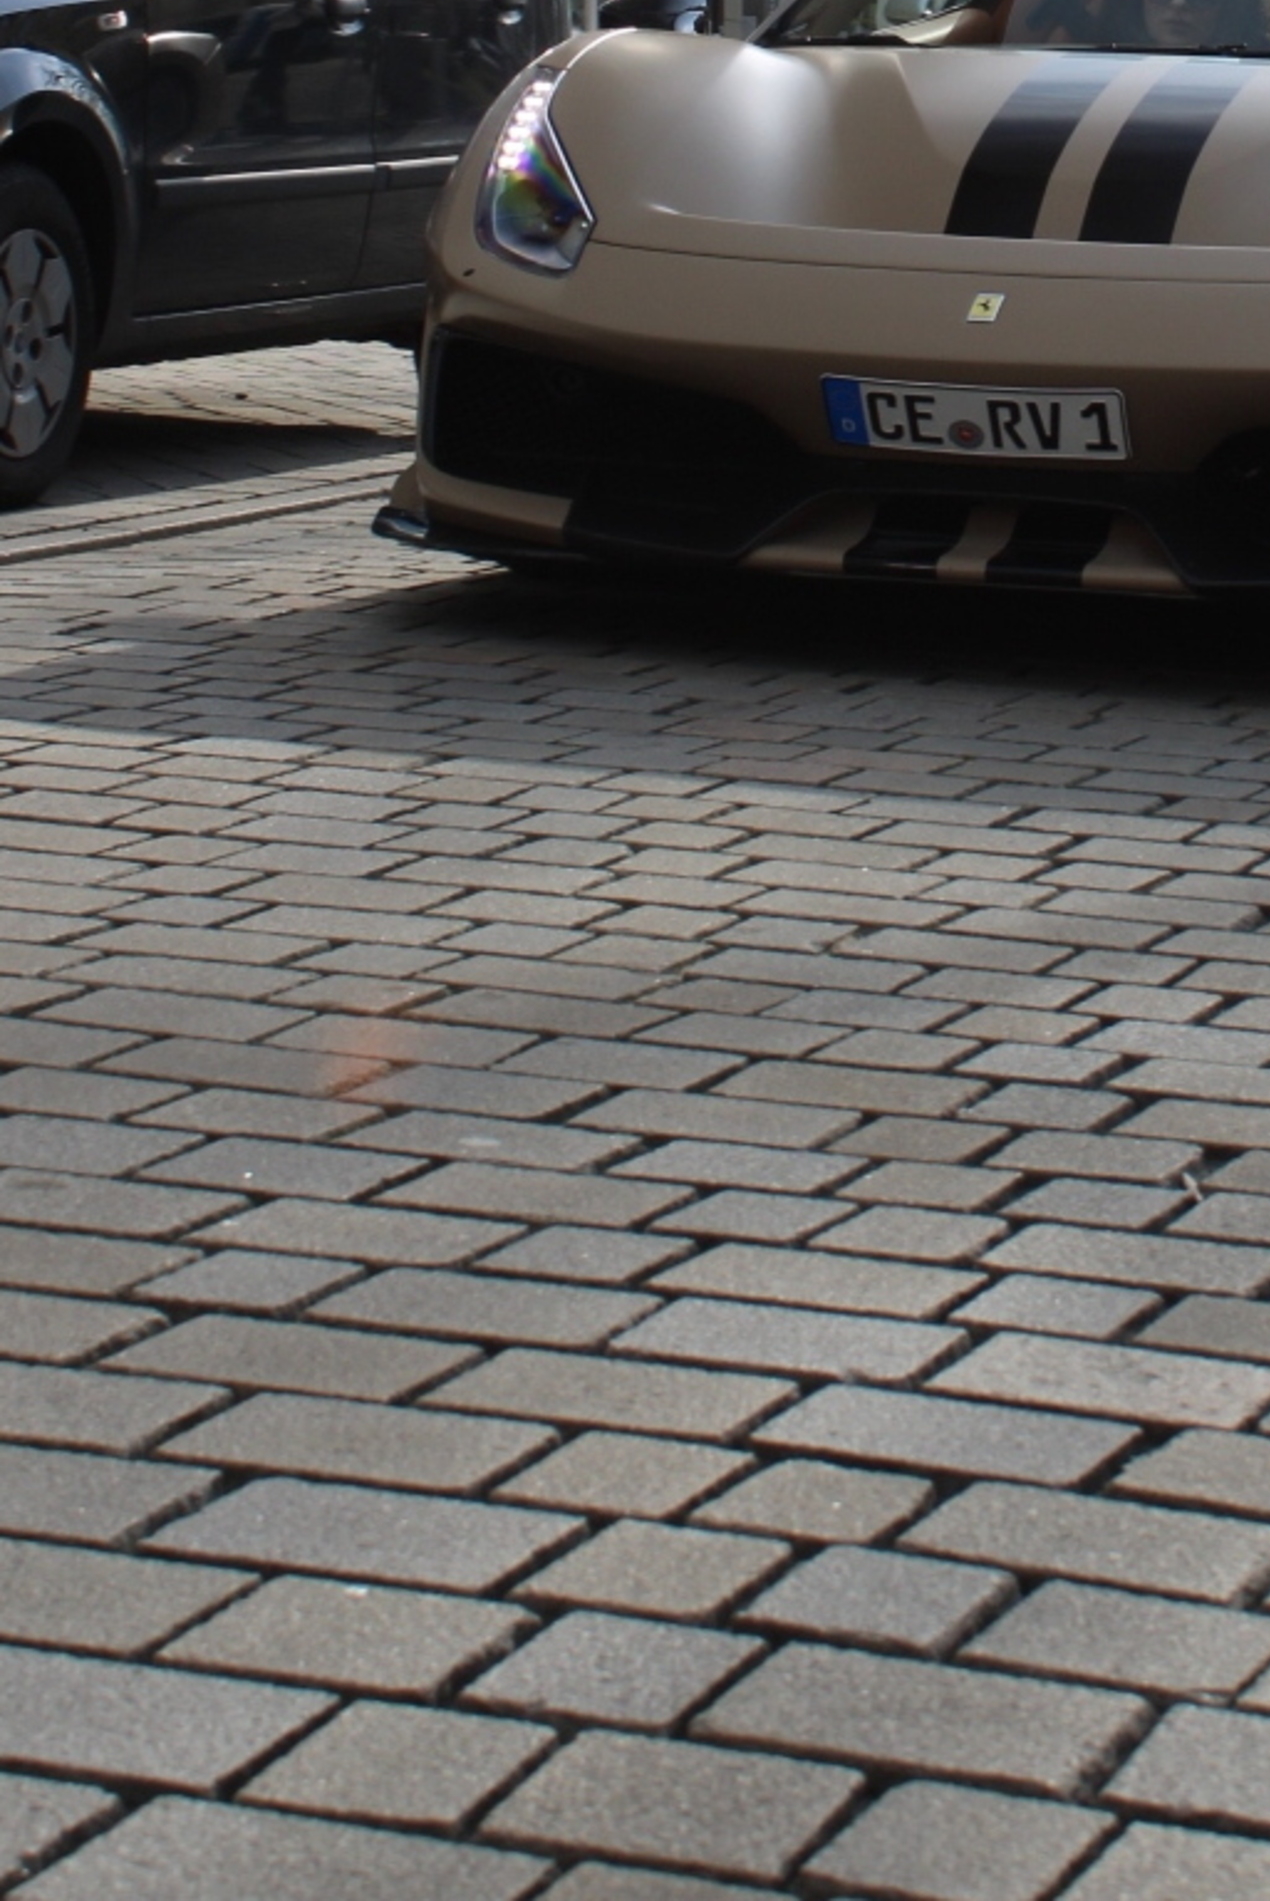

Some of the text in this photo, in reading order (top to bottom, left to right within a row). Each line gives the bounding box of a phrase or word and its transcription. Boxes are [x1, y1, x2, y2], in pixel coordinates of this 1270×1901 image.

[866, 391, 944, 445] CE
[986, 400, 1060, 450] RV
[1080, 402, 1118, 452] 1
